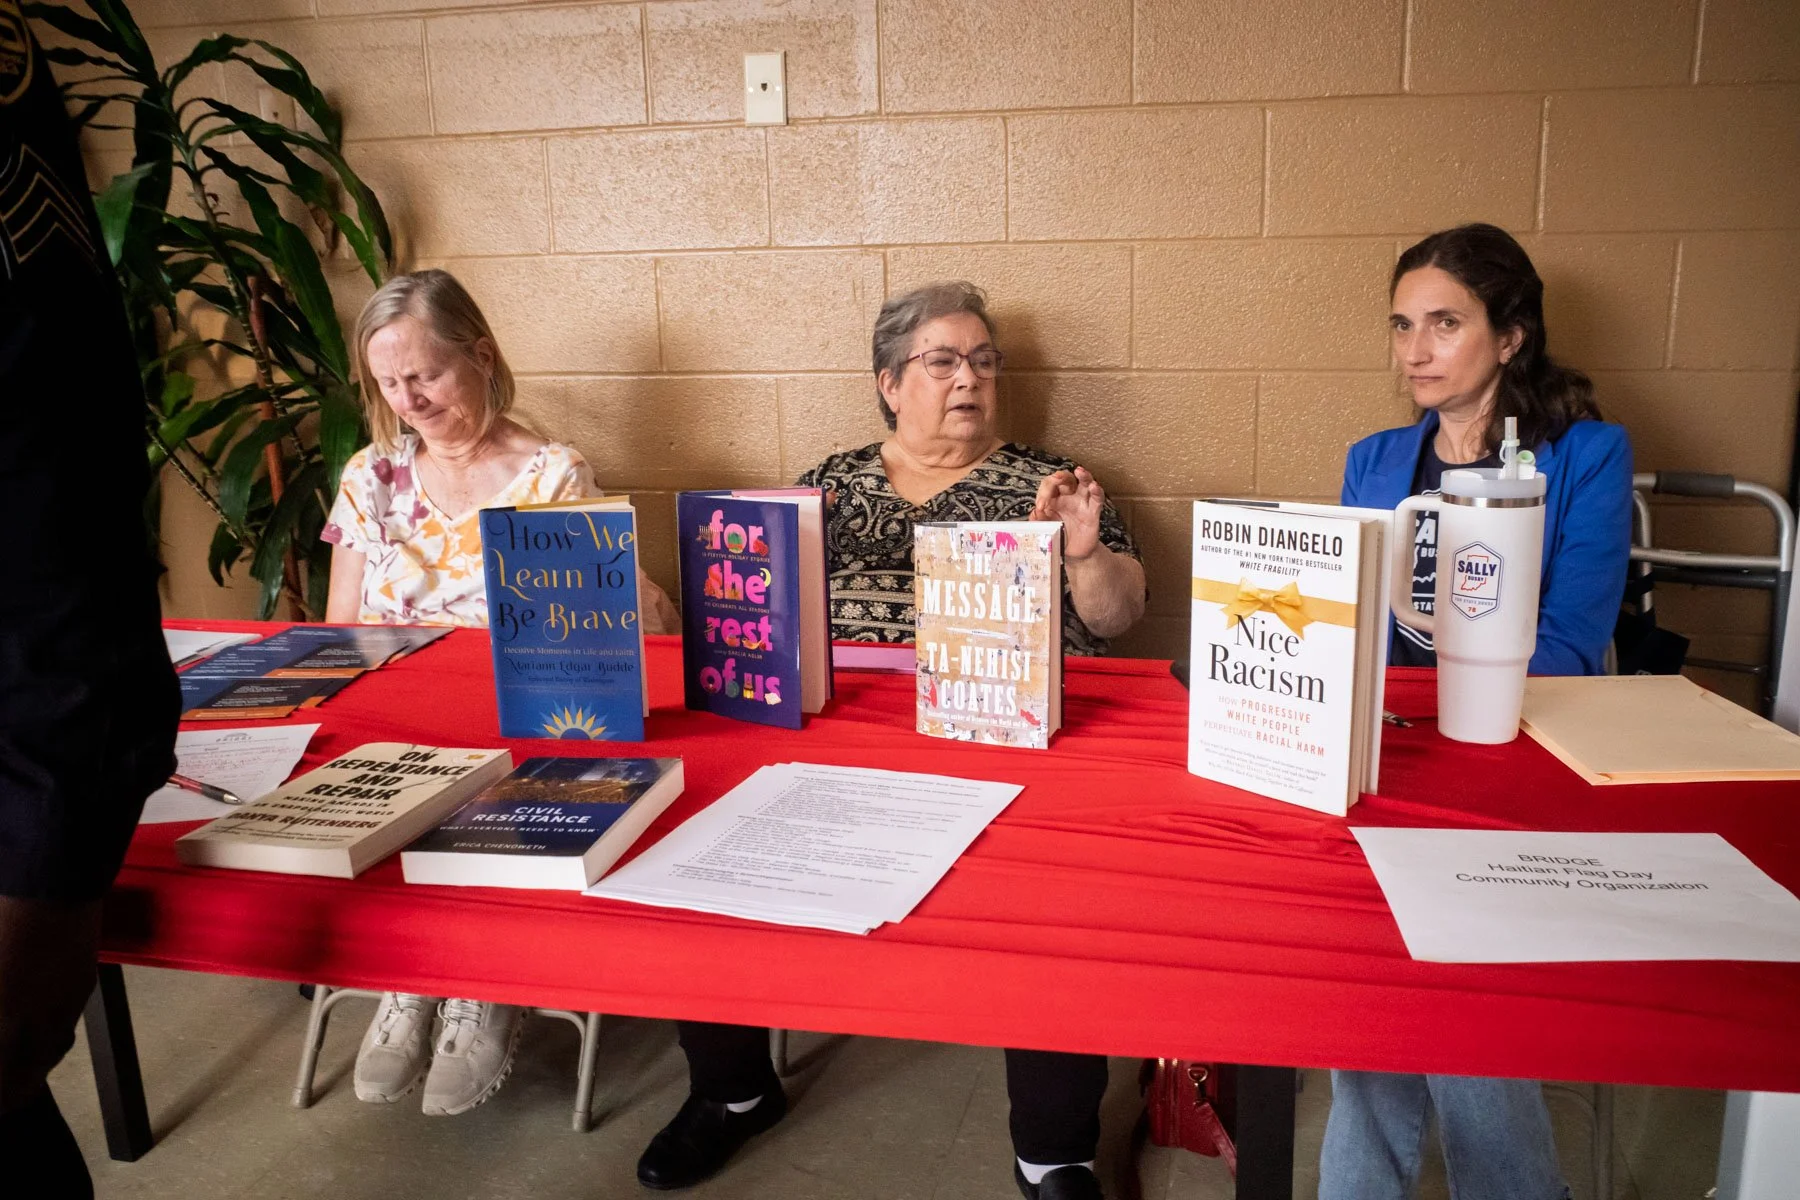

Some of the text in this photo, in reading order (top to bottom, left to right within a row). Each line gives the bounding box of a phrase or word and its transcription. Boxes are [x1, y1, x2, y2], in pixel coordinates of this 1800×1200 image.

[486, 511, 634, 551] How We
[708, 509, 768, 556] for
[1202, 518, 1343, 557] ROBIN DIANGELO
[964, 553, 992, 576] THE
[1201, 545, 1222, 554] AUTHOR
[1254, 552, 1266, 560] NEW
[1269, 554, 1283, 563] YORK
[1286, 556, 1303, 566] TIMES
[1306, 560, 1343, 571] BESTSELLER
[1240, 560, 1301, 577] WHITE FRAGILITY
[1457, 560, 1497, 576] SALLY
[488, 548, 627, 601] Learn To
[704, 560, 769, 604] the
[923, 578, 1038, 624] MESSAGE
[495, 603, 637, 642] Be Brave
[706, 615, 773, 651] rest
[1234, 613, 1299, 658] Nice
[537, 647, 571, 656] Moments
[926, 642, 1032, 682] TA-NEHISI
[560, 661, 592, 675] Edgar
[599, 661, 634, 675] Budde
[1208, 643, 1326, 704] Racism
[700, 658, 782, 705] of us
[940, 679, 1017, 717] COATES
[1218, 694, 1312, 724] HOW PROGRESSIVE
[1227, 709, 1300, 736] WHITE PEOPLE
[1204, 719, 1325, 757] PERPETUATE RACIAL HARM
[324, 759, 474, 776] REPENTANCE
[399, 751, 439, 763] ON
[305, 783, 402, 801] REPAIR
[346, 773, 404, 787] AND
[271, 804, 354, 815] UNAPOLOGETIC
[283, 796, 326, 805] MAKING
[328, 799, 373, 808] AMENDS
[515, 806, 563, 815] CIVIL
[226, 812, 382, 829] DANYA RUTTENBERG
[472, 814, 592, 824] RESISTANCE
[1488, 863, 1654, 880] Haitian Flag Day
[1518, 853, 1604, 867] BRIDGE
[1456, 872, 1709, 891] Community Organization
